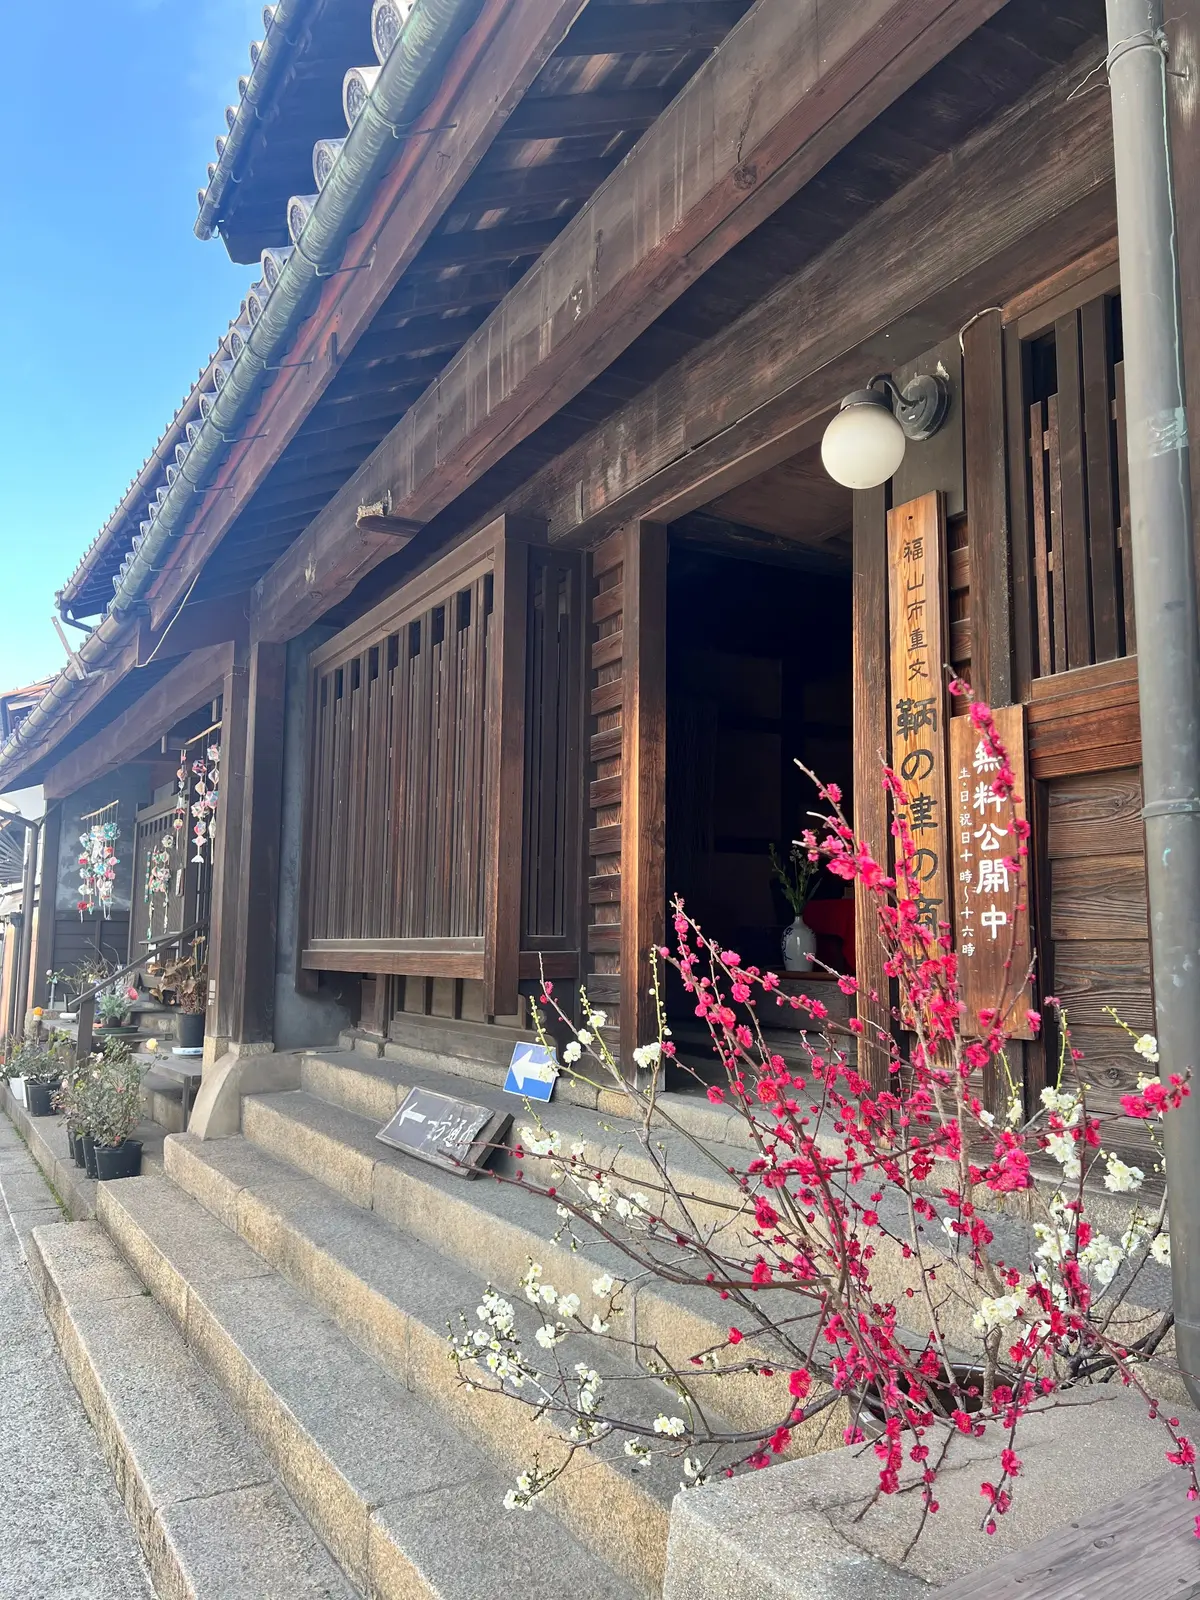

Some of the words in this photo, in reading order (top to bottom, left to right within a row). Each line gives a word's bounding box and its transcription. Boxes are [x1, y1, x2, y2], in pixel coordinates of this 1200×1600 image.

[903, 536, 928, 681] 福山市重文
[972, 740, 1009, 939] 無料公開中
